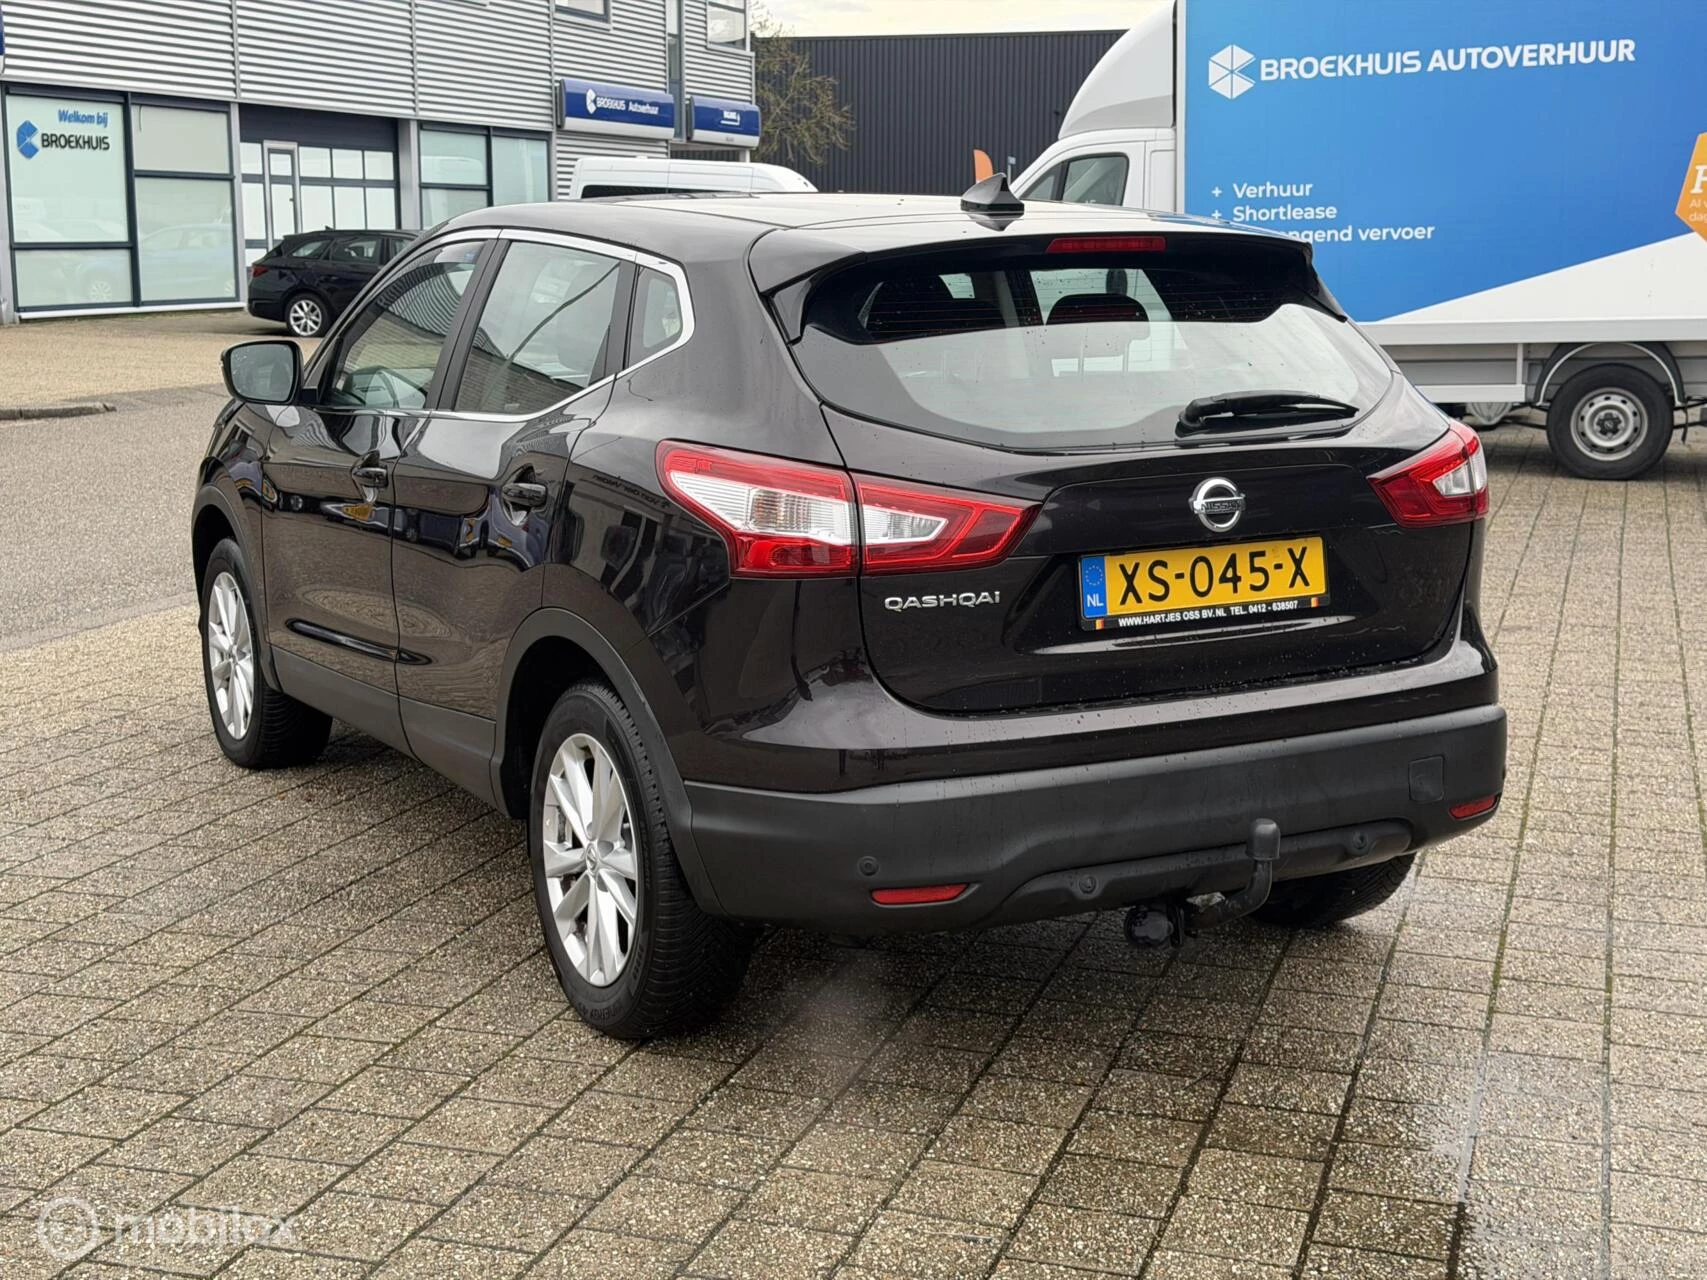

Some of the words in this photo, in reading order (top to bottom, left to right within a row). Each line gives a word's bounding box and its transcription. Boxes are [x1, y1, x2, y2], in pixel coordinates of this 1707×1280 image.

[1260, 50, 1422, 81] BROEKHUIS
[1427, 38, 1636, 72] AUTOVERHUUR
[58, 109, 96, 124] Welkom
[96, 112, 109, 128] bij
[41, 133, 110, 151] BROEKHUIS
[1232, 181, 1314, 199] Verhuur
[1232, 204, 1338, 222] Shortlease
[1282, 225, 1353, 244] ngend
[1358, 226, 1435, 241] vervoer
[1118, 546, 1311, 606] XS-045-X
[884, 590, 1000, 612] QASHQAI
[1086, 594, 1104, 607] NL
[1118, 613, 1181, 627] WWW.HARTJES
[1182, 610, 1201, 620] OSS
[1248, 603, 1267, 614] 0412
[1272, 600, 1299, 611] 638507
